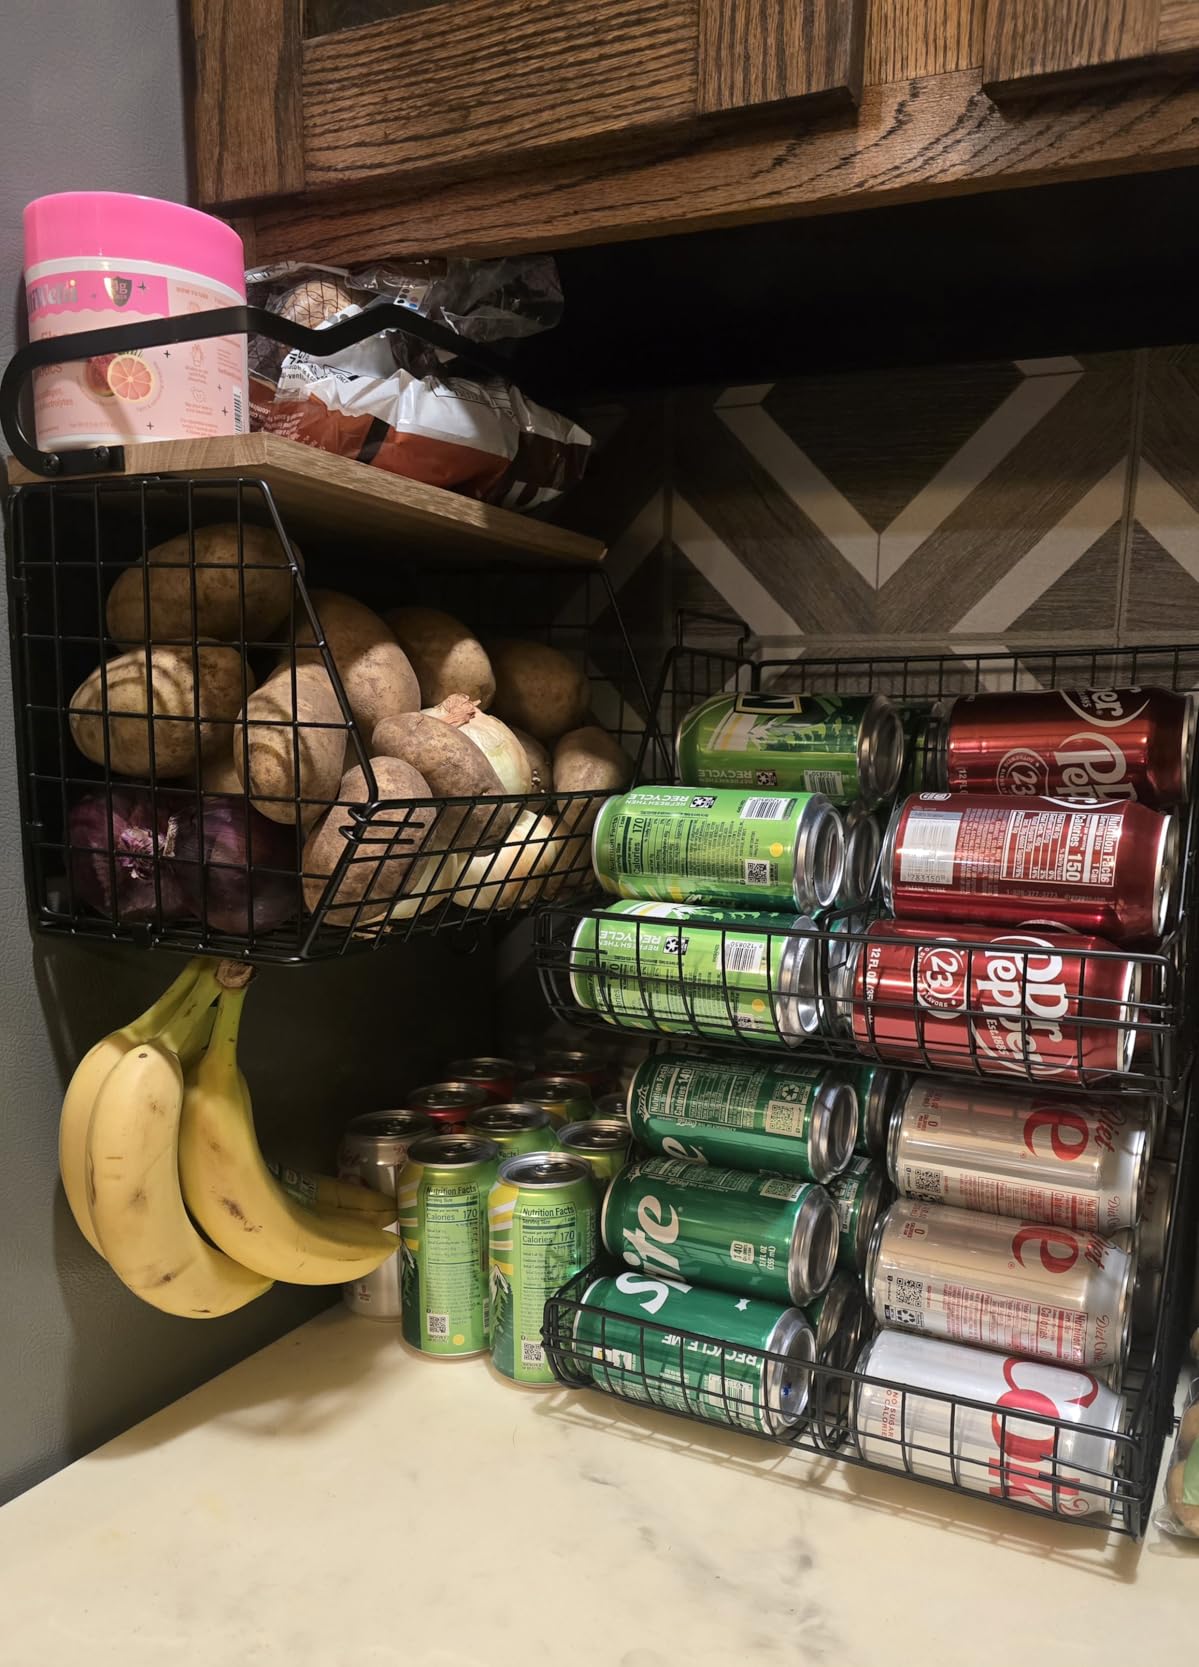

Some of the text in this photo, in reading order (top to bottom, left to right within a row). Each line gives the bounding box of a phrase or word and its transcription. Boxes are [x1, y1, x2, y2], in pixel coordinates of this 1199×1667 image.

[698, 769, 752, 778] RECYCLE
[1010, 770, 1038, 795] 23
[627, 793, 689, 801] RECYCLE
[1096, 815, 1107, 835] Serving
[632, 818, 644, 874] Calories 170
[1066, 814, 1086, 881] Calories 150
[1094, 837, 1103, 850] size
[1101, 816, 1121, 883] Nutrition Facts
[868, 959, 878, 970] FL
[871, 947, 881, 958] 12
[926, 956, 958, 987] 23
[1025, 983, 1068, 1042] Dr
[651, 1066, 668, 1112] Nutrition Facts
[674, 1069, 691, 1116] Calories 140
[427, 1185, 477, 1196] Nutrition Facts
[427, 1209, 478, 1221] Calories 170
[522, 1207, 574, 1217] Nutrition Facts
[1107, 1196, 1120, 1217] Diet
[523, 1230, 575, 1243] Calories 170
[734, 1243, 742, 1259] 140
[1040, 1307, 1051, 1339] Calories
[1074, 1314, 1086, 1346] Nutrition
[1094, 1315, 1110, 1363] Diet Coke
[882, 1399, 890, 1436] CALORIE
[888, 1392, 898, 1437] NO SUGAR
